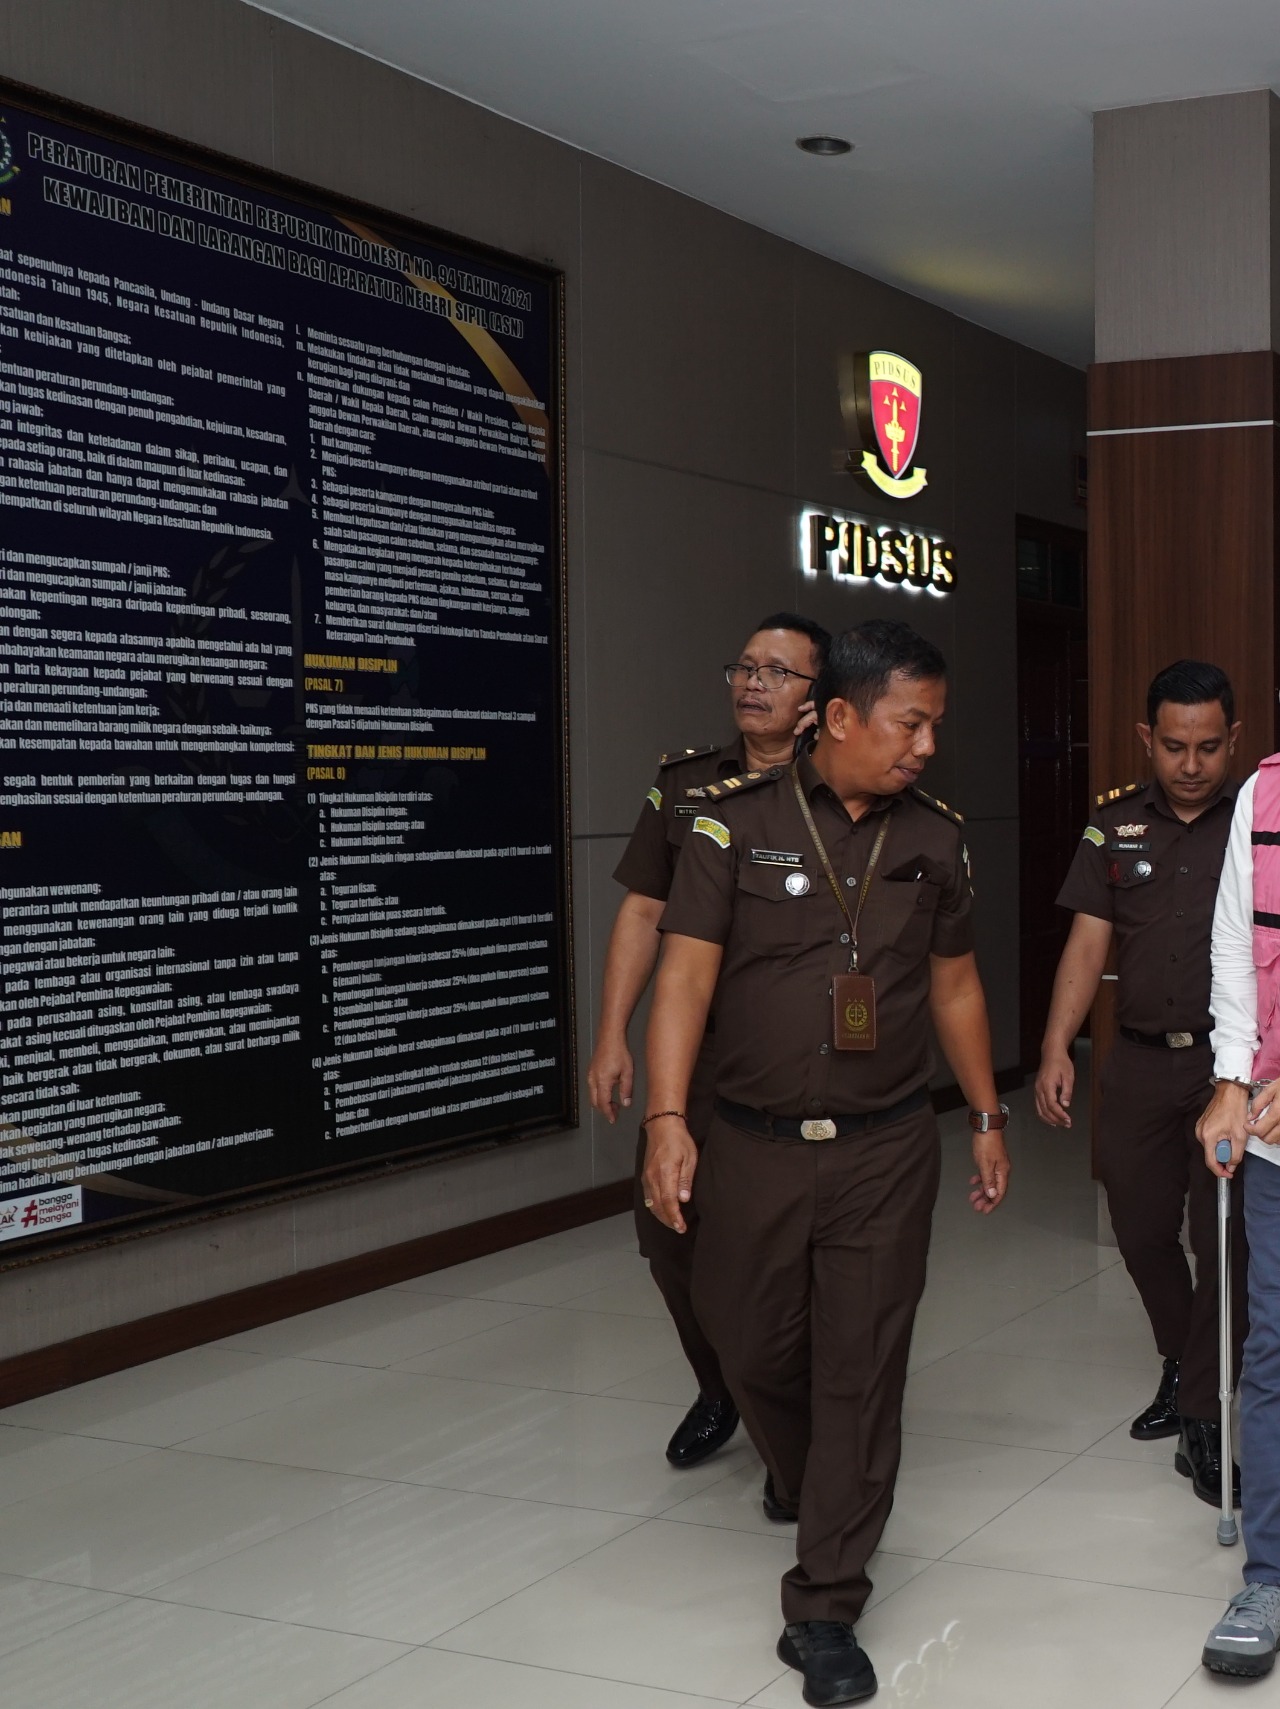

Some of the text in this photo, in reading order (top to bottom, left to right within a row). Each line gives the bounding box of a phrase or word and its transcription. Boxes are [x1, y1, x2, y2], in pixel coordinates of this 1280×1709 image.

[27, 131, 531, 311] PERATURAN PEMERINTAH REPUBLIK INDONESIA NO. 94 TAHUN 2021
[43, 175, 523, 339] KEWAJIBAN DAN LARANGAN BAGI APARATUR NEGERI SIPIL (ASN)
[17, 253, 73, 277] sepenuhnya
[77, 267, 110, 286] kepada
[113, 276, 157, 299] Pancasila,
[160, 289, 190, 308] Undang
[201, 299, 230, 318] Undang
[233, 307, 254, 323] Dasar
[257, 314, 283, 330] Negara
[51, 278, 284, 348] Tahun 1945, Negara Kesatuan Republik Indonesia,
[295, 340, 305, 351] m.
[23, 327, 285, 397] kebijakan yang ditetapkan oleh pejabat pemerintah yang
[873, 360, 917, 389] PIDSUS
[17, 418, 287, 477] integritas dan keteladanan dalam sikap, perilaku, ucapan, dan
[309, 433, 315, 443] 1.
[8, 457, 43, 472] rahasia
[47, 461, 82, 478] jabatan
[85, 468, 102, 481] dan
[106, 471, 132, 486] hanya
[163, 481, 226, 500] mengemukakan
[229, 491, 258, 505] rahasia
[260, 494, 288, 509] jabatan
[806, 514, 957, 593] PIDSUS
[30, 588, 291, 624] kepentingan negara daripada kepentingan pribadi, seseorang,
[303, 653, 397, 673] HUKUMAN DISIPLIN
[304, 677, 342, 692] (PASAL 7)
[18, 737, 76, 750] kesempatan
[78, 738, 112, 751] kepada
[154, 739, 178, 750] untuk
[180, 740, 247, 752] mengembangkan
[306, 744, 486, 760] TINGKAT DAN JENIS HUKUMAN DISIPLIN
[3, 774, 36, 787] segala
[40, 774, 73, 785] bentuk
[77, 773, 125, 787] pemberian
[129, 775, 150, 786] yang
[197, 774, 226, 786] dengan
[229, 773, 251, 786] tugas
[255, 773, 269, 784] dan
[306, 766, 345, 780] (PASAL 8)
[2, 903, 49, 919] perantara
[51, 901, 78, 914] untuk
[80, 897, 139, 911] mendapatkan
[141, 894, 189, 907] keuntungan
[191, 890, 219, 905] pribadi
[220, 890, 235, 901] dan
[242, 889, 259, 900] atau
[261, 888, 282, 899] orang
[283, 885, 297, 897] lain
[331, 884, 358, 896] Teguran
[14, 1015, 299, 1066] menjual, membeli, menggadaikan, menyewakan, atau meminjamkan
[2, 1071, 24, 1086] baik
[26, 1065, 69, 1082] bergerak
[72, 1062, 92, 1075] atau
[95, 1058, 117, 1071] tidak
[120, 1051, 160, 1067] bergerak,
[162, 1046, 202, 1061] dokumen,
[204, 1043, 222, 1054] atau
[224, 1038, 244, 1051] surat
[246, 1034, 280, 1048] berharga
[39, 1193, 72, 1205] bangga
[39, 1199, 79, 1216] melayani
[0, 1214, 15, 1225] AK
[39, 1212, 72, 1224] bangsa
